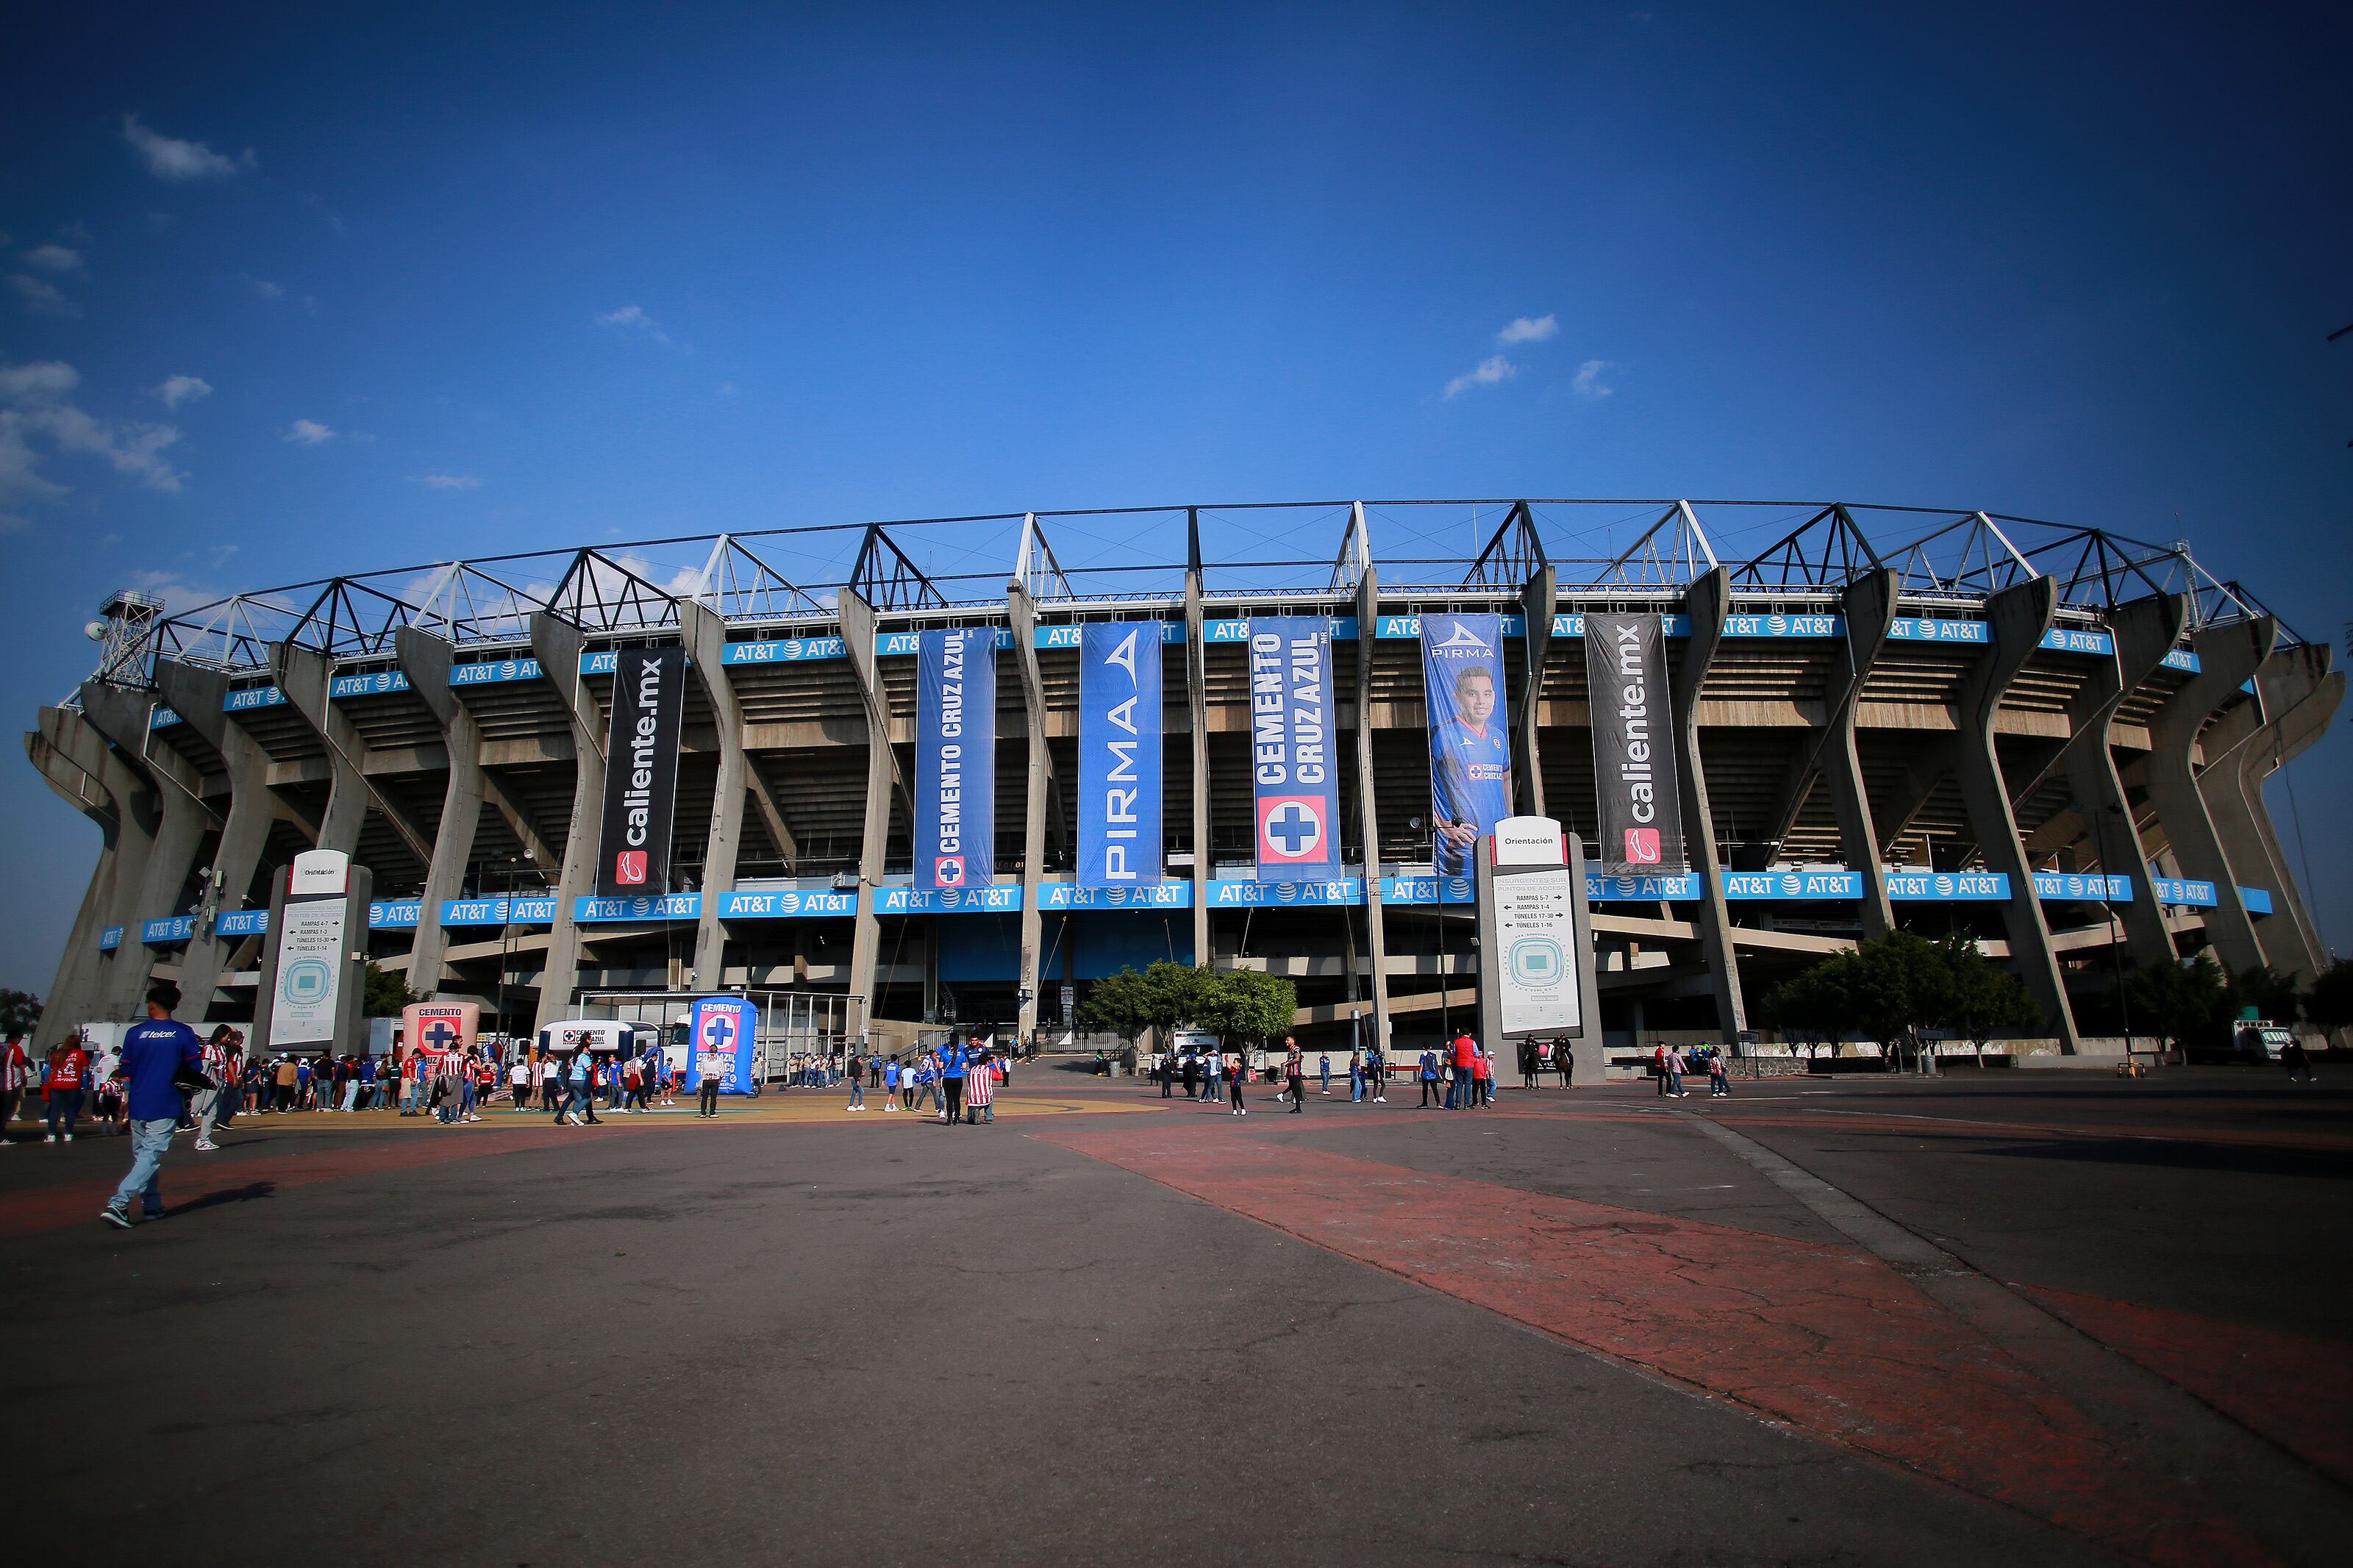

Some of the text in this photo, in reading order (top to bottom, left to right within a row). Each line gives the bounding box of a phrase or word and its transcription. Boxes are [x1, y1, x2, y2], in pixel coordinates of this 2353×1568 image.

[1792, 618, 1835, 634] AT&T
[1940, 623, 1982, 639] AT&T
[733, 644, 776, 661] AT&T
[2070, 634, 2102, 652] AT&T
[943, 629, 965, 681] AZUL
[1432, 648, 1495, 659] PIRMA
[2168, 652, 2191, 668] AT&T
[457, 661, 543, 681] AT&T AT
[336, 677, 371, 694] AT&T
[232, 691, 263, 707] AT&T
[1290, 631, 1327, 784] CRUZ AZUL MR
[941, 682, 963, 738] CRUZ
[1252, 632, 1288, 786] CEMENTO
[1616, 624, 1655, 824] caliente.mx
[623, 657, 663, 847] caliente.mx
[1105, 695, 1138, 880] PIRMA
[939, 744, 962, 853] CEMENTO
[1050, 885, 1181, 905] AT&T AT&T
[1218, 882, 1352, 903] AT&T AT&T
[1392, 881, 1441, 900] AT&T
[1643, 877, 1690, 895] AT&T
[1727, 876, 1852, 895] AT&T AT&T
[1887, 877, 1999, 895] AT&T AT&T
[2186, 884, 2209, 901] AT&T
[585, 897, 696, 917] AT&T AT&T
[729, 894, 851, 913] AT&T AT&T
[886, 889, 1013, 908] AT&T AT&T
[386, 905, 422, 922] AT&T
[449, 901, 557, 920] AT&T AT&T
[148, 923, 169, 938] AT&T
[224, 915, 254, 931] AT&T
[701, 1003, 742, 1014] CEMENTO
